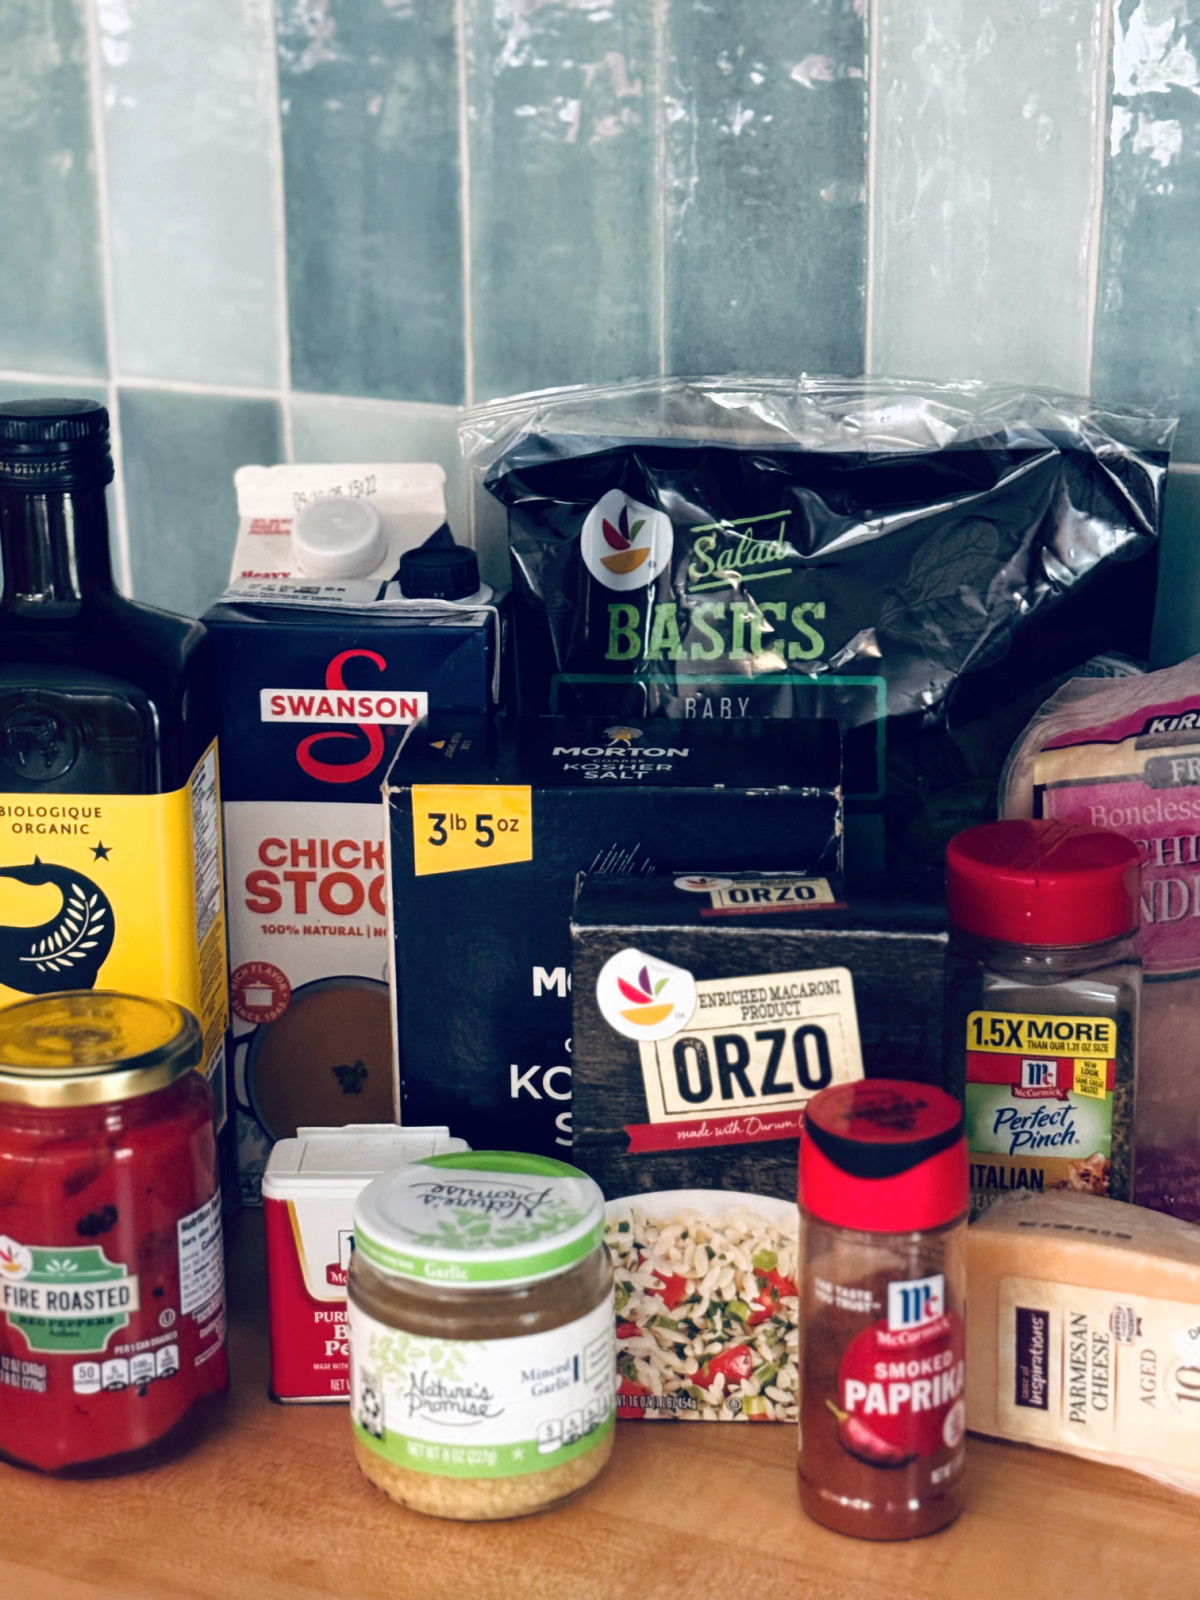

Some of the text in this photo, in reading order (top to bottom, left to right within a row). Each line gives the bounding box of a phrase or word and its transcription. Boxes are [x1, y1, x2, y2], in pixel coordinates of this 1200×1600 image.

[688, 520, 787, 579] Salad
[605, 602, 826, 661] BASICS
[270, 695, 418, 719] SWANSON
[685, 697, 749, 719] BABY
[552, 747, 689, 757] MORTON
[563, 763, 672, 771] KOSHER
[584, 771, 648, 779] SALT
[0, 805, 102, 819] BIOLOGIQUE
[1089, 797, 1200, 827] Boneless
[12, 823, 90, 834] ORGANIC
[728, 885, 816, 903] ORZO
[261, 924, 299, 935] 100%
[303, 925, 363, 937] NATURAL
[699, 980, 841, 1009] ENRICHED MACARONI
[742, 1001, 801, 1021] PRODUCT
[972, 1017, 1109, 1048] 1.5X MORE
[1027, 1040, 1109, 1053] THAN OUR 1.31 OZ SIZE
[672, 1024, 833, 1104] ORZO
[1081, 1067, 1099, 1077] LOOK
[1084, 1061, 1097, 1069] NEW
[1014, 1086, 1063, 1098] McCormick
[677, 1121, 712, 1139] made
[715, 1120, 744, 1136] with
[743, 1116, 796, 1135] Durum
[993, 1104, 1078, 1135] Perfect
[1009, 1121, 1077, 1156] Pinch
[970, 1164, 1044, 1190] ITALIAN
[424, 1261, 469, 1281] Garlic
[4, 1284, 130, 1311] FIRE ROASTED
[48, 1316, 115, 1327] PEPPERS
[79, 1365, 95, 1379] 50
[521, 1354, 570, 1384] Minced
[874, 1350, 953, 1380] SMOKED
[1029, 1315, 1046, 1406] Inspirations
[1069, 1311, 1087, 1424] PARMESAN
[1091, 1332, 1109, 1412] CHEESE
[331, 1379, 345, 1391] NET
[410, 1370, 494, 1400] Nature's
[531, 1375, 571, 1397] Garlic
[845, 1359, 964, 1415] PAPRIKA
[1140, 1348, 1157, 1408] AGED
[405, 1391, 505, 1418] Promise
[677, 1397, 697, 1410] 454g
[407, 1440, 424, 1458] NET
